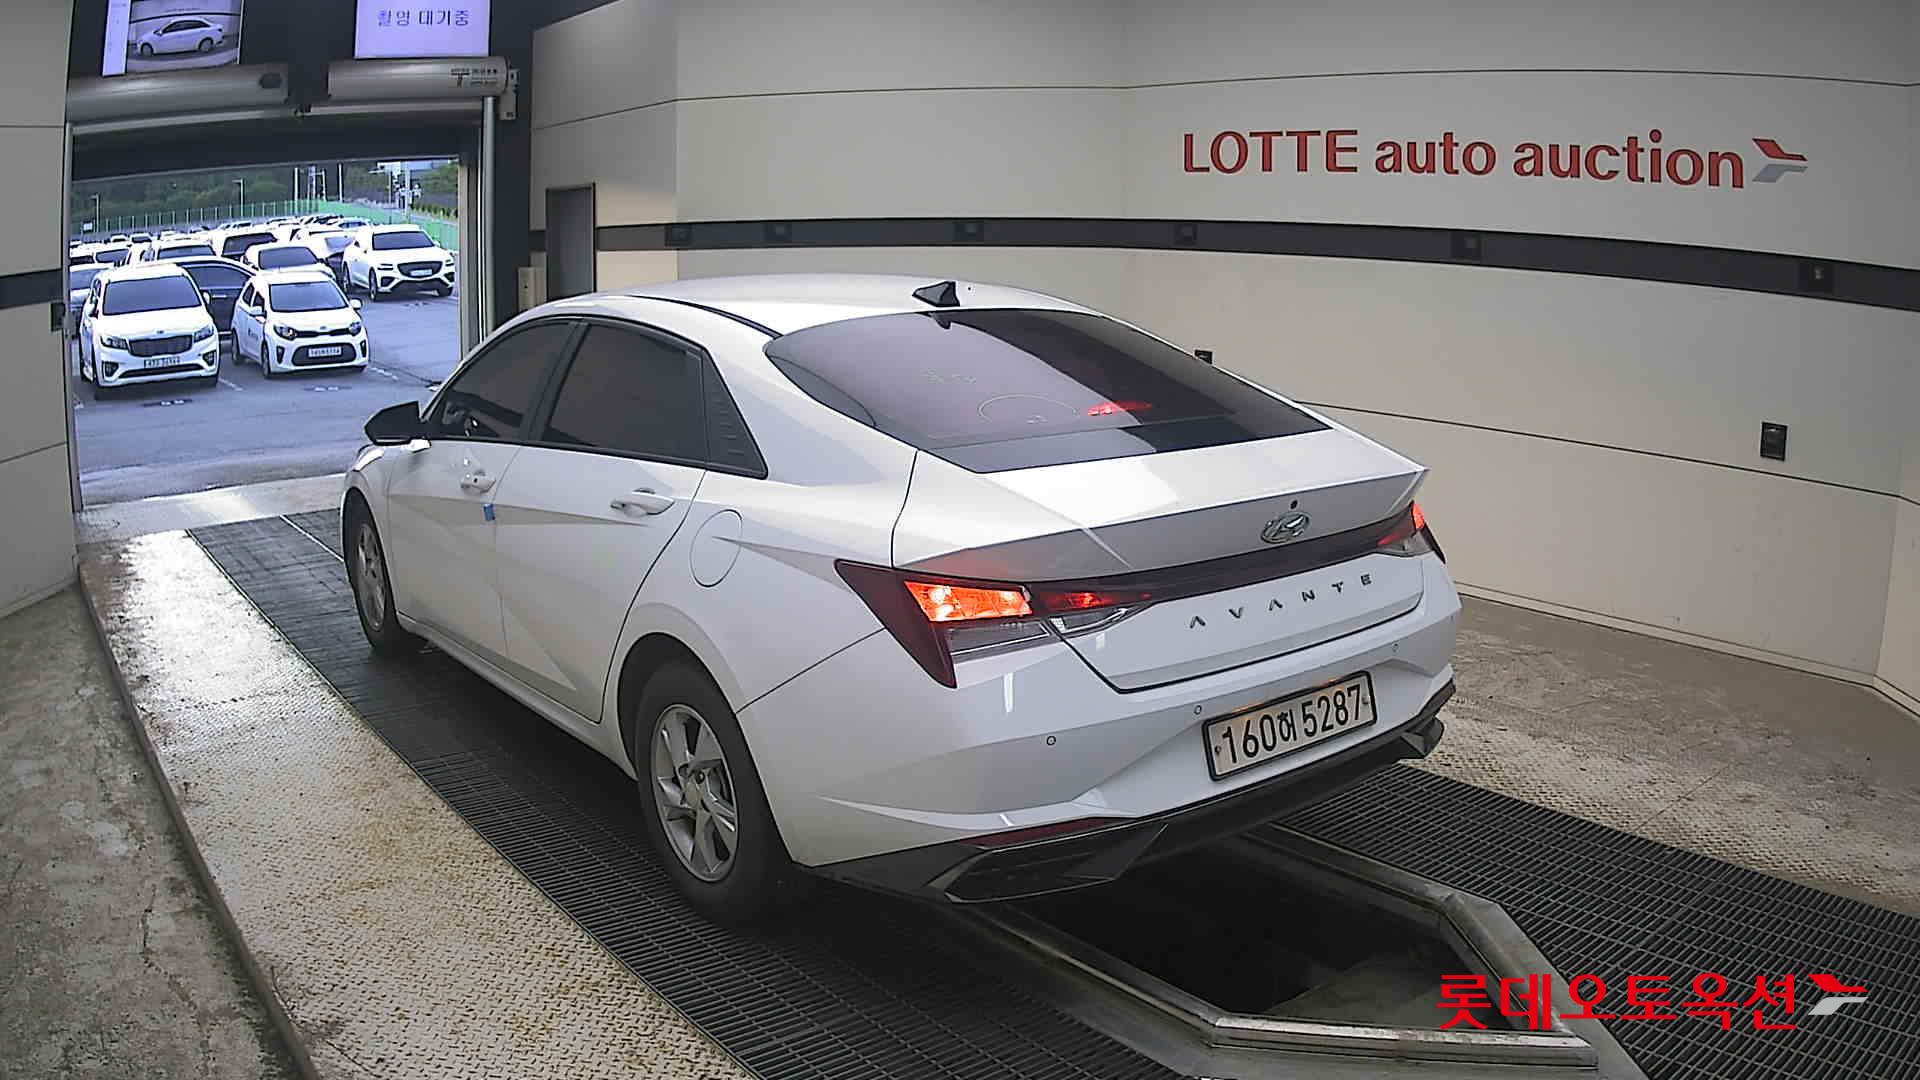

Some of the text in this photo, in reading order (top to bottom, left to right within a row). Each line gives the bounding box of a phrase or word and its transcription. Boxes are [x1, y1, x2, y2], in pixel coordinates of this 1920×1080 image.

[418, 9, 469, 27] 대기중
[1183, 128, 1745, 189] LOTTE auto auction
[1189, 573, 1372, 629] AVANTE
